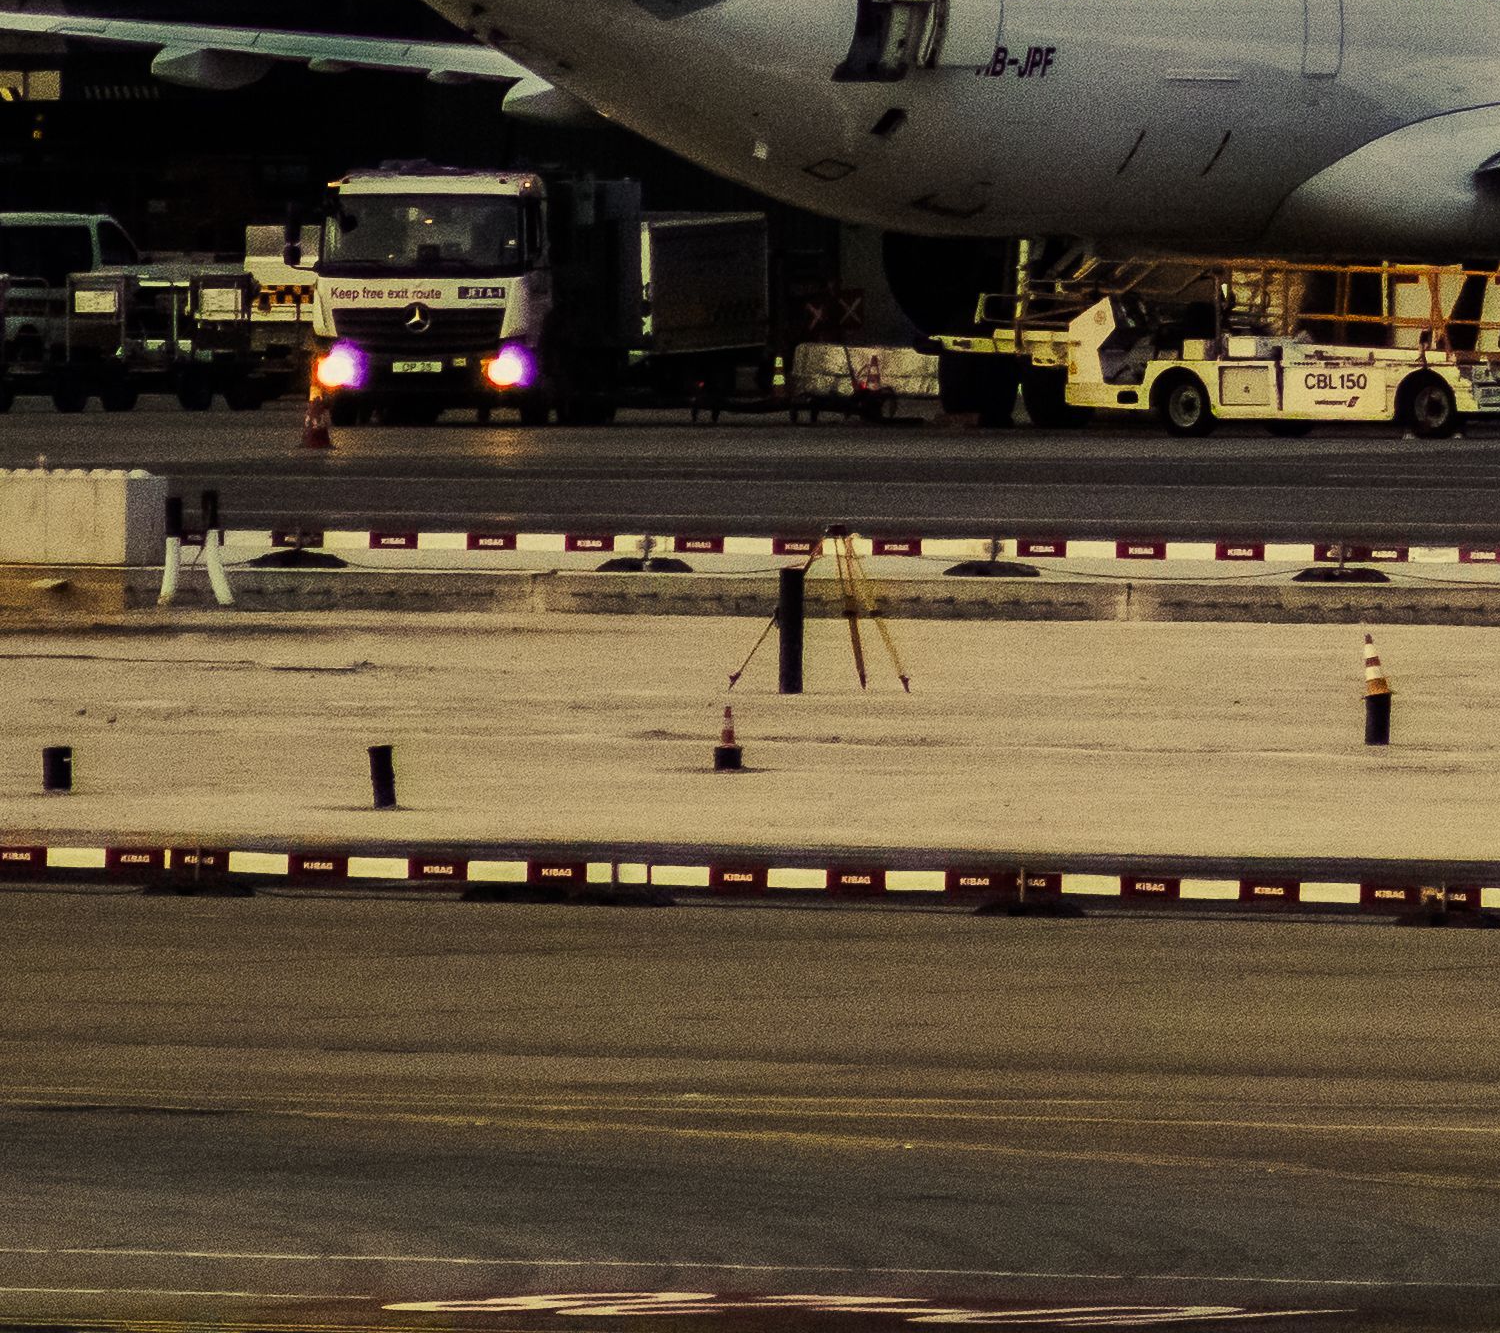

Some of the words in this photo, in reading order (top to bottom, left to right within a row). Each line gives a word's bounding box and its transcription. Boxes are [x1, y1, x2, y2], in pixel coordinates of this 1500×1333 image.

[330, 286, 359, 301] Keep
[362, 286, 384, 300] free
[387, 286, 408, 300] exit
[412, 287, 441, 300] route
[465, 288, 483, 298] JET
[2, 852, 31, 861] KIBAG
[120, 854, 150, 863] KIBAG
[303, 861, 333, 870] KIBAG
[423, 865, 453, 874] KIBAG
[542, 868, 572, 877] KIBAG
[723, 873, 753, 882] KIBAG
[841, 876, 871, 884] KIBAG
[960, 878, 989, 886] KIBAG
[1135, 883, 1165, 892] KIBAG
[1254, 887, 1284, 895] KIBAG
[1375, 890, 1405, 899] KIBAG
